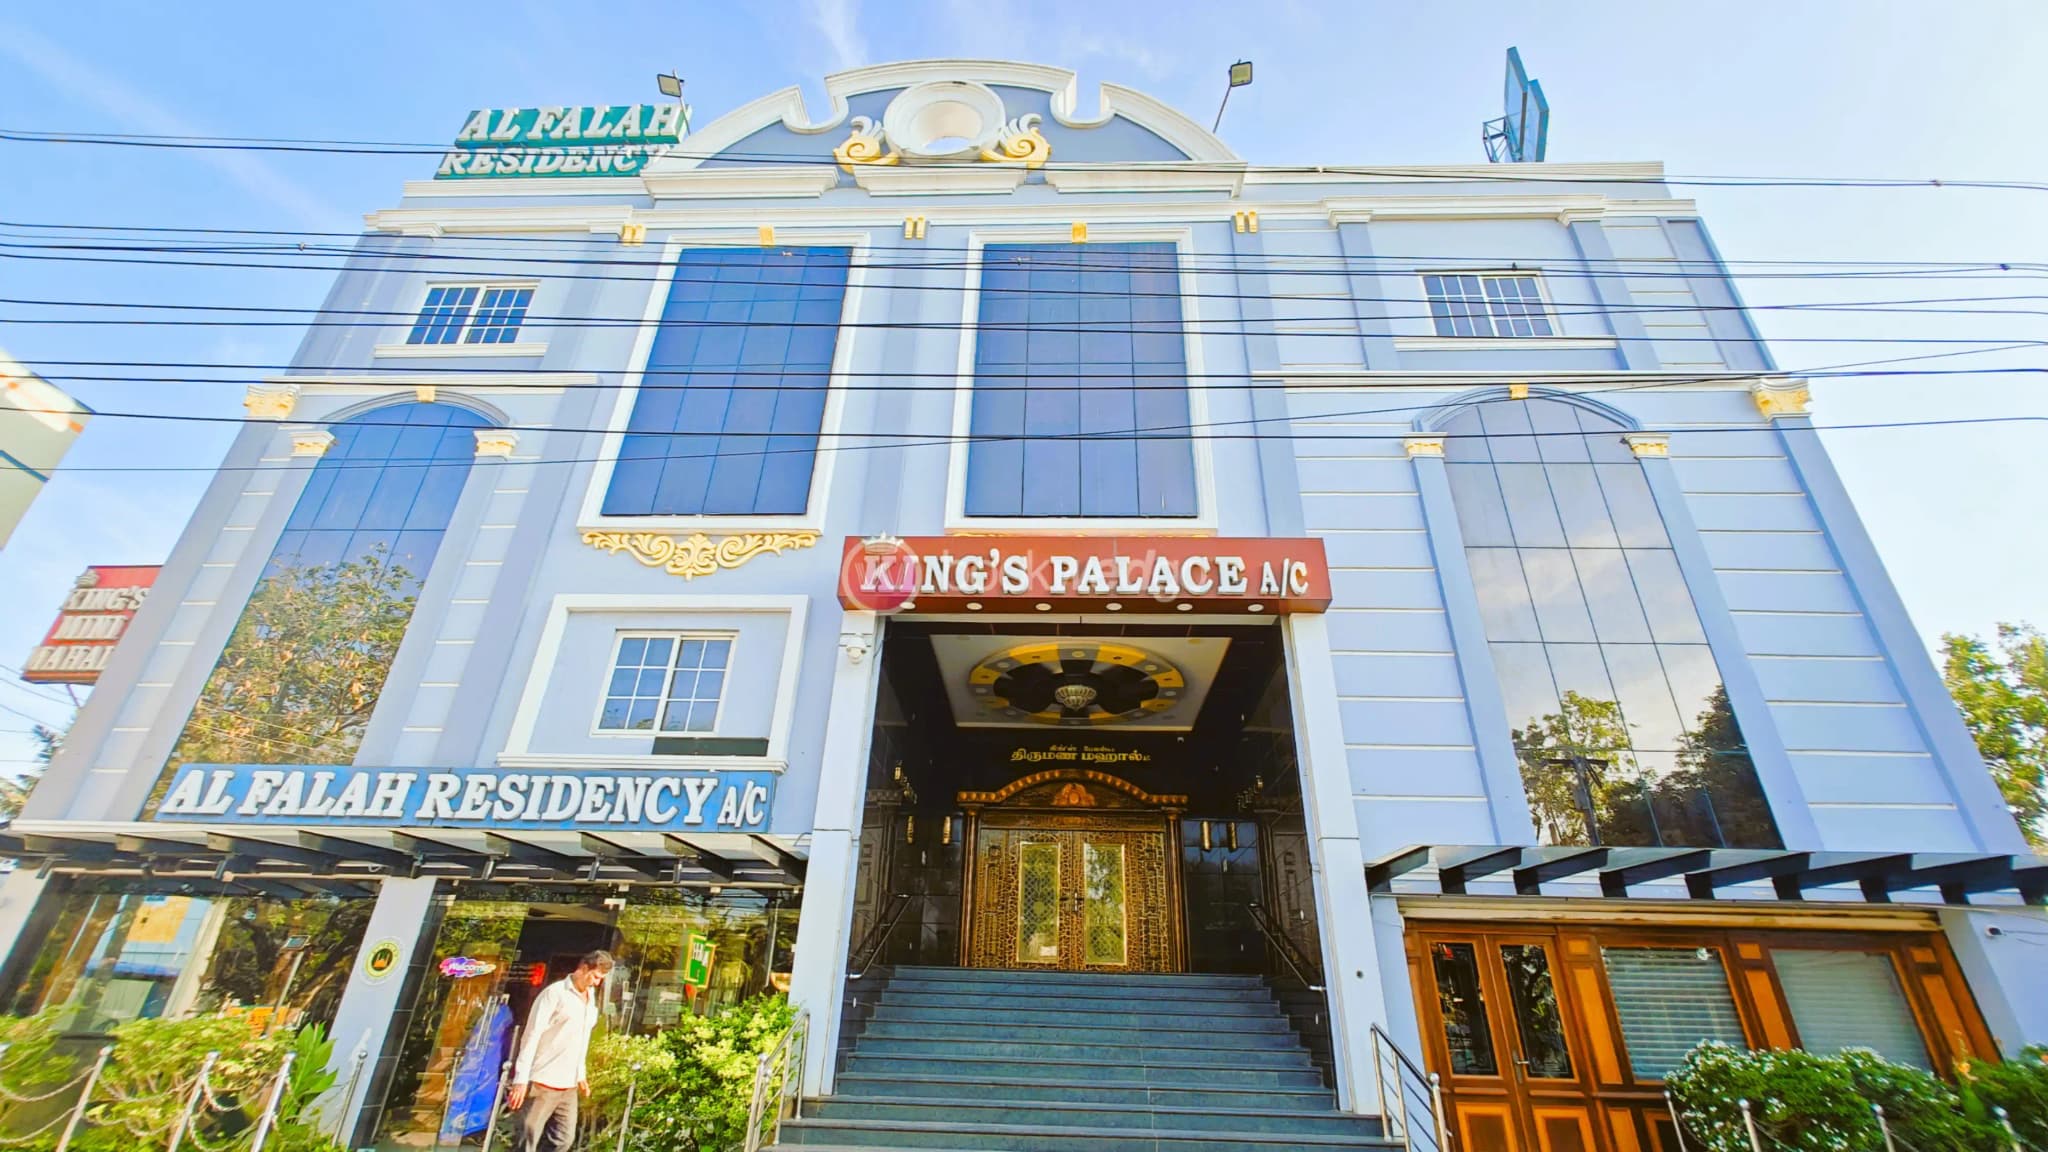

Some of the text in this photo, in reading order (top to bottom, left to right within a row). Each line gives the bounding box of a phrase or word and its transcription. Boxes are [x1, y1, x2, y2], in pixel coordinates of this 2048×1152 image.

[457, 104, 682, 141] AL FALAH
[438, 144, 669, 175] RESIDENCY
[860, 548, 1309, 598] KING'S PALACE A/C
[1010, 748, 1078, 762] திருமண
[1081, 749, 1143, 763] மஹால்
[159, 770, 767, 828] AL FALAH RESIDENCY A/C
